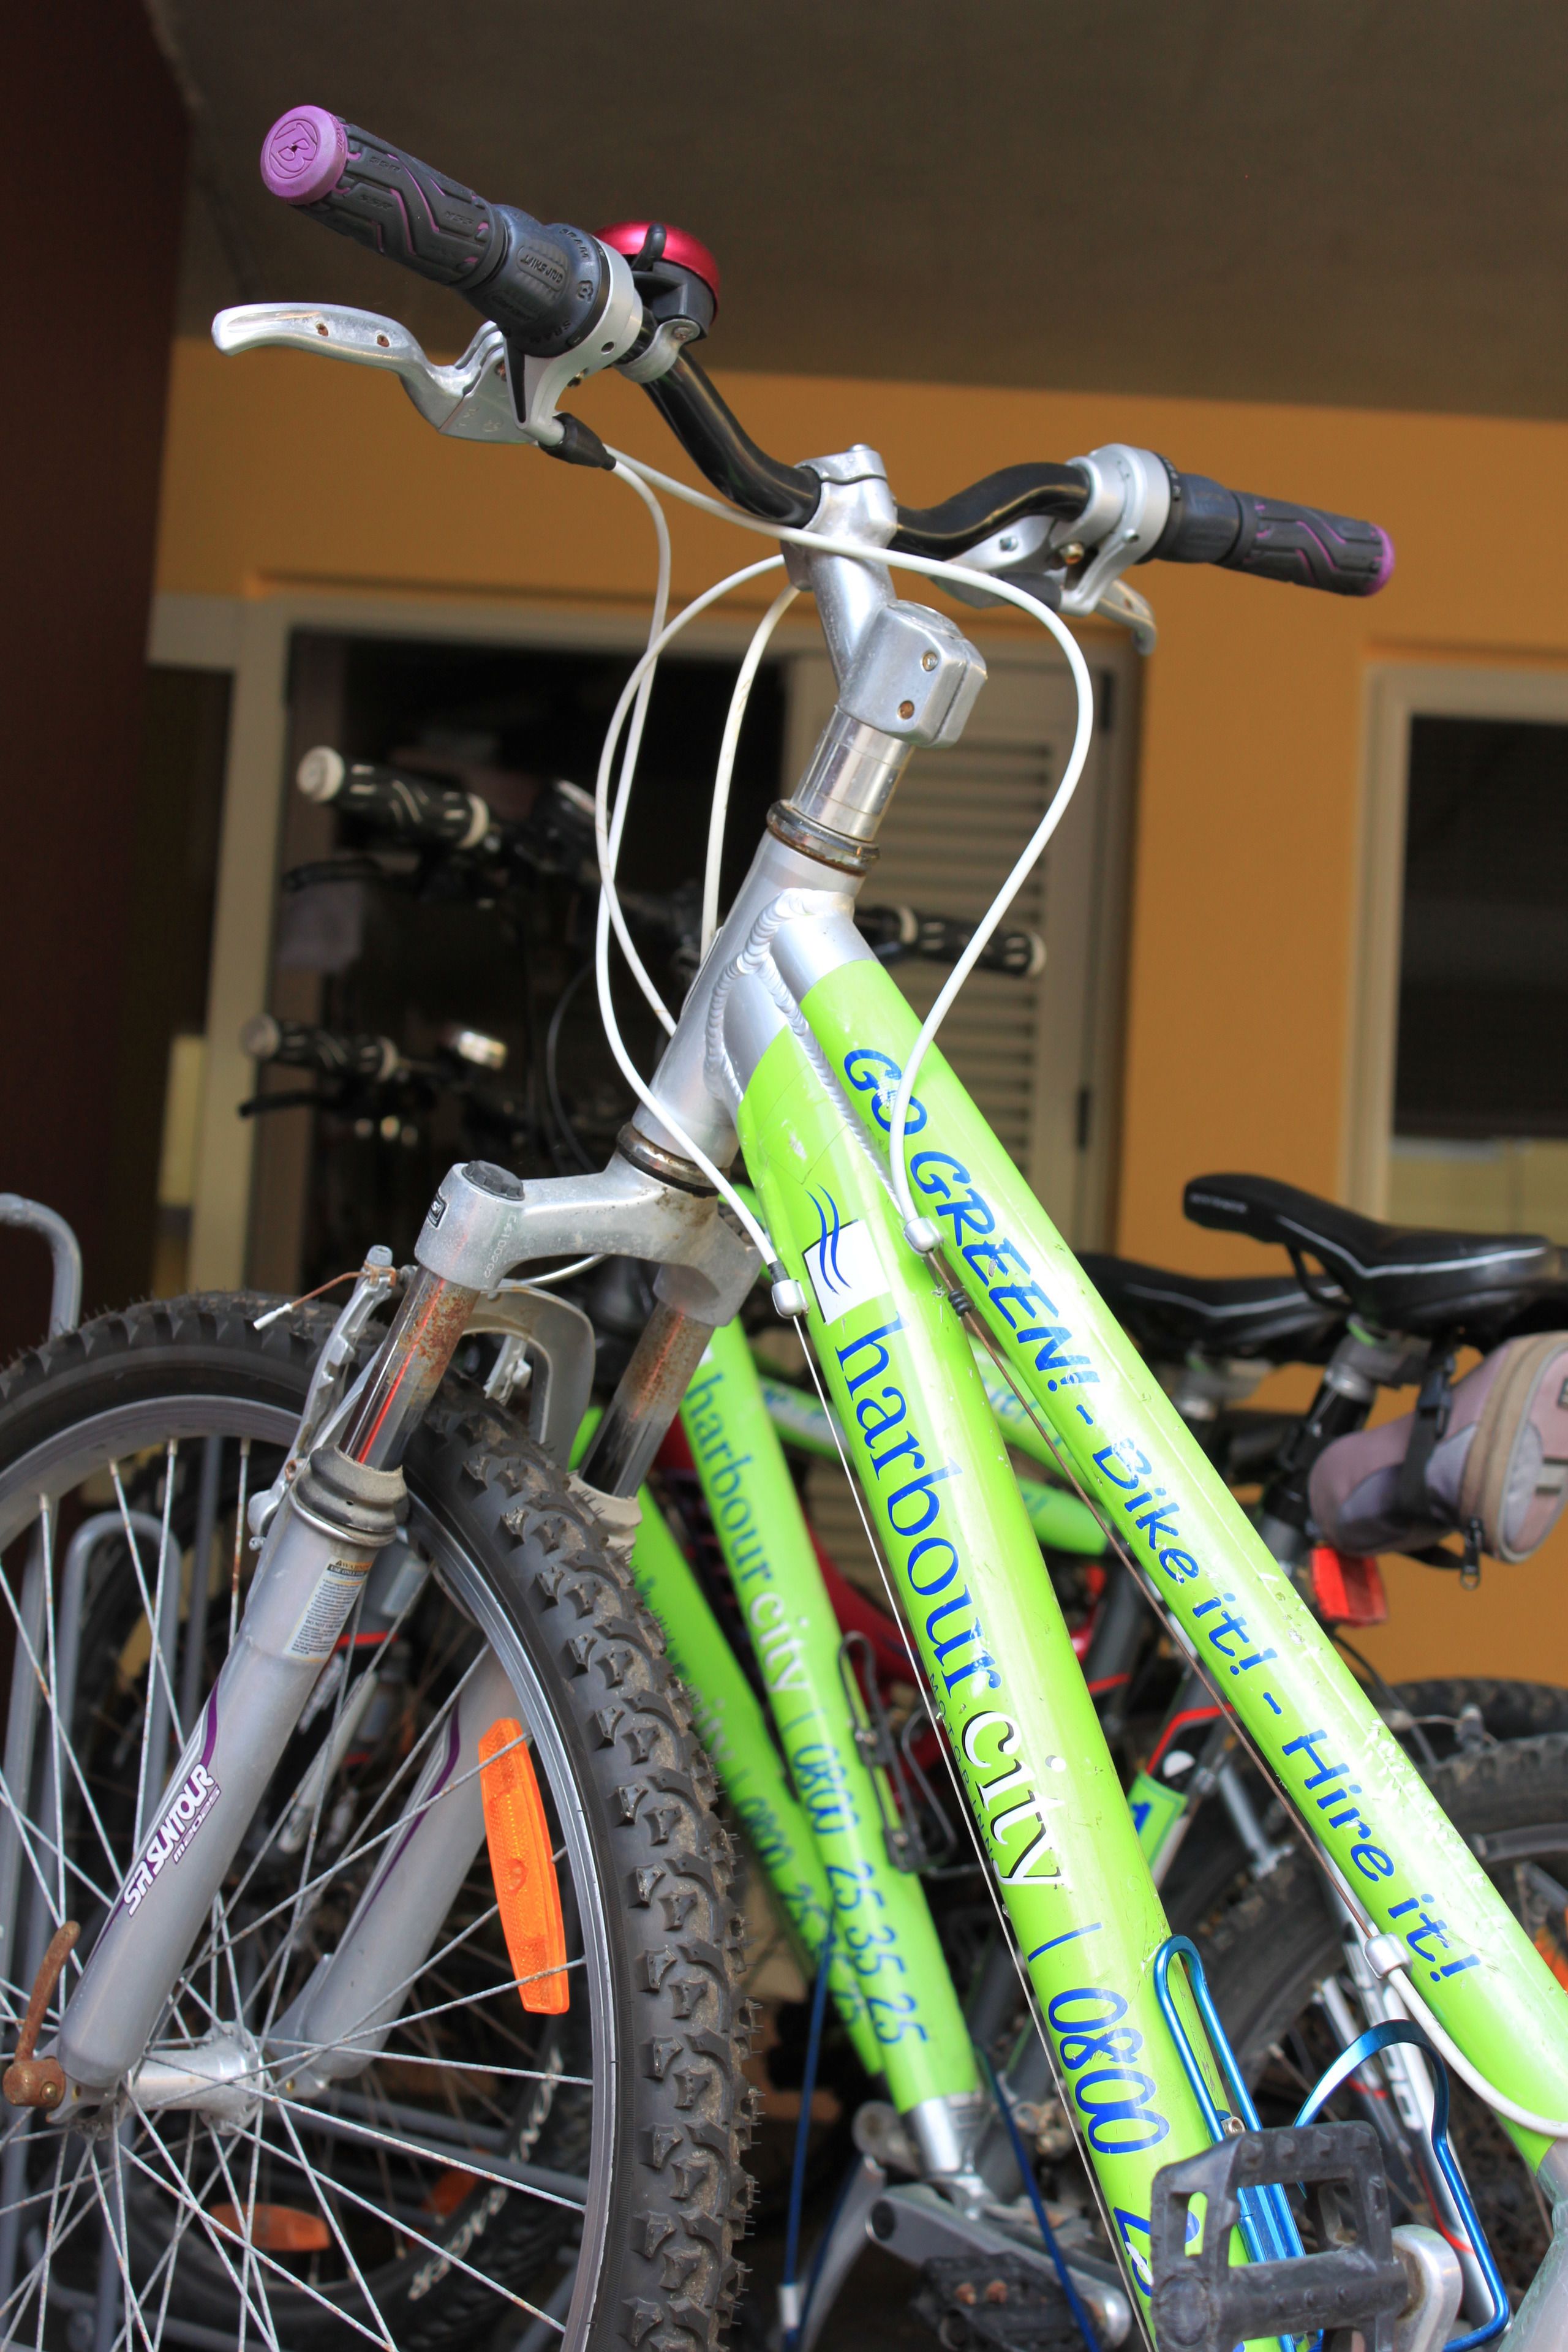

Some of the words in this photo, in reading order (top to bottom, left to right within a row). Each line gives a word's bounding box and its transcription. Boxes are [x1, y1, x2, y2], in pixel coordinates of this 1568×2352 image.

[684, 1372, 772, 1583] harbour
[843, 1049, 927, 1136] GO
[910, 1152, 1100, 1392] GREEN!
[1092, 1438, 1199, 1583] Bike
[1193, 1593, 1278, 1676] it!
[1282, 1728, 1395, 1882] Hire
[1388, 1893, 1480, 1982] it!
[751, 1592, 812, 1693] city
[835, 1311, 1001, 1698] harbour
[962, 1711, 1074, 1885] city
[1048, 1987, 1169, 2154] 0800
[793, 1743, 861, 1835] 0800
[124, 1860, 155, 1917] SR
[145, 1763, 216, 1879] SUNTOUR
[825, 1860, 885, 1912] 25
[845, 1924, 906, 1977] 35
[866, 1992, 929, 2046] 25
